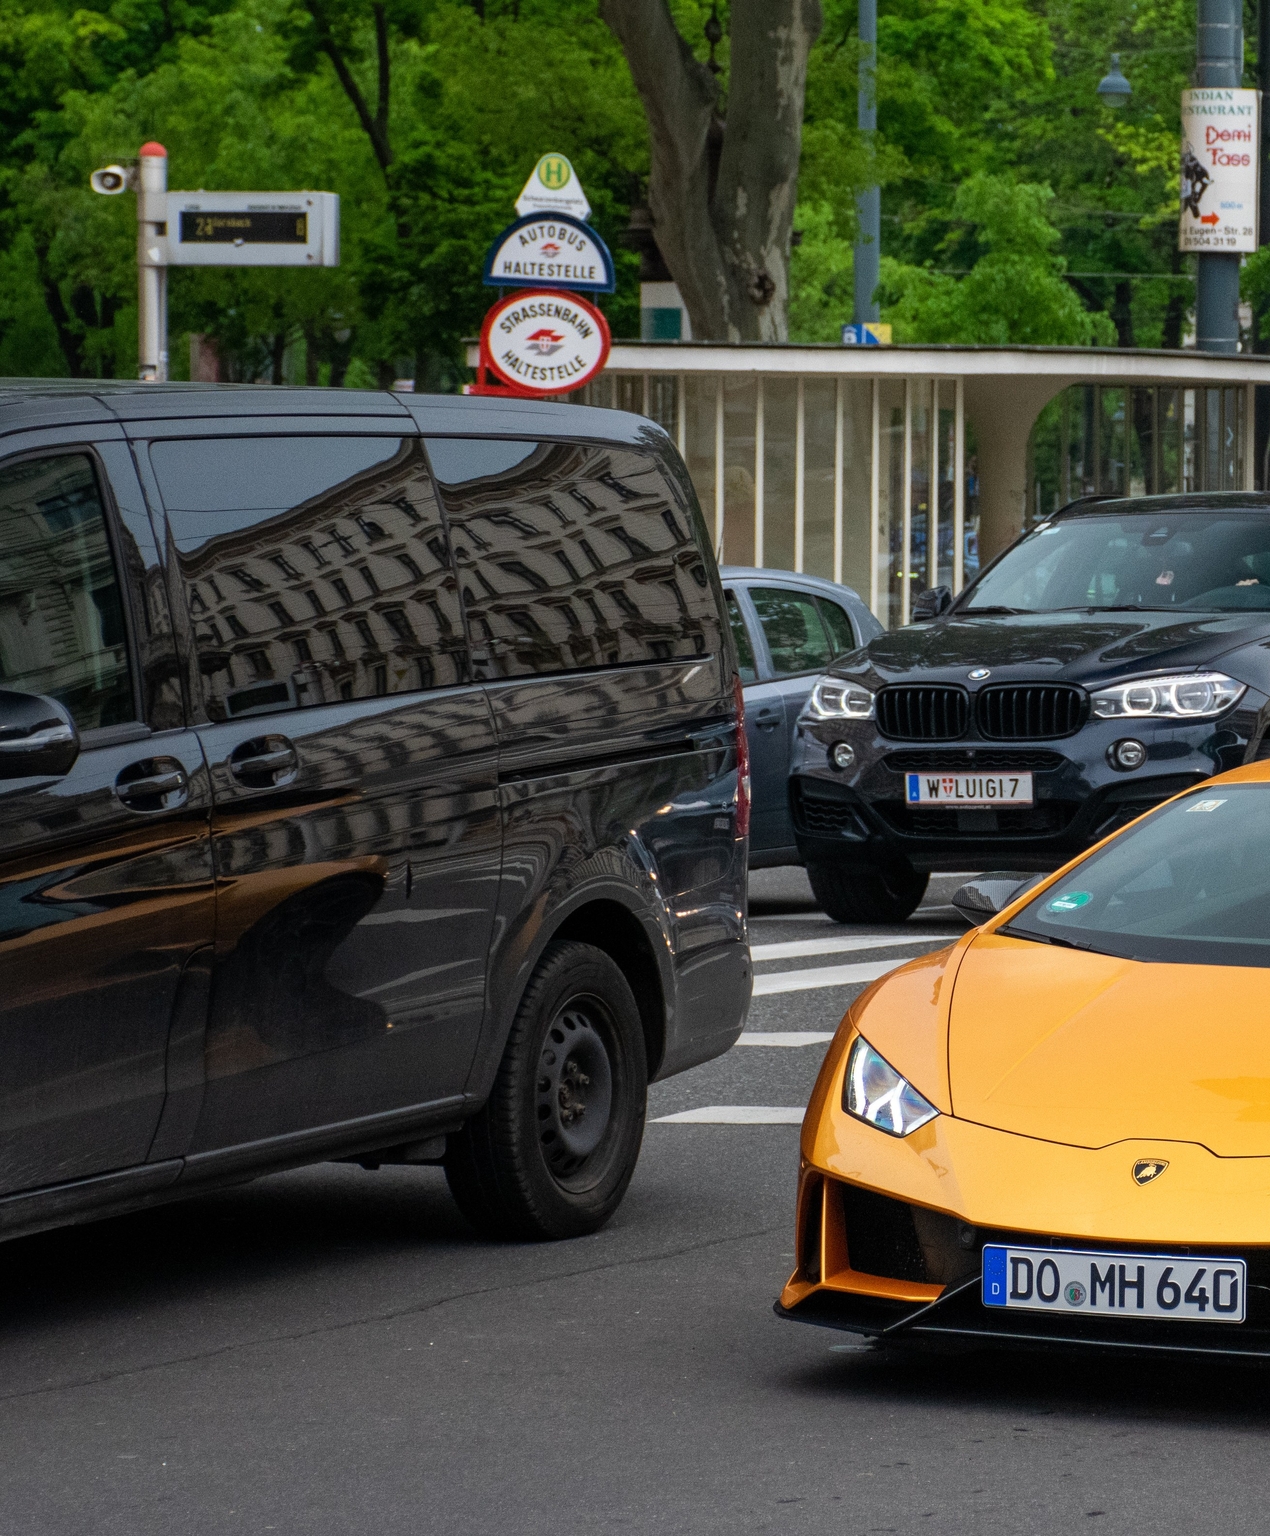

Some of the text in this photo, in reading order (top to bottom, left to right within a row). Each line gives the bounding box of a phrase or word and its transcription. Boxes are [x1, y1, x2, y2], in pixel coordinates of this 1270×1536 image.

[1190, 91, 1233, 100] INDIAN
[1205, 124, 1251, 145] Demi
[1206, 147, 1250, 166] Tass
[546, 162, 562, 182] H
[518, 225, 587, 252] AUTOBUS
[503, 261, 596, 280] HALTESTELLE
[500, 303, 594, 339] STRASSENBAHN
[501, 349, 587, 381] HALTESTELLE
[926, 779, 940, 798] W
[991, 1283, 1000, 1295] D
[1009, 1256, 1239, 1313] DO MH 640
